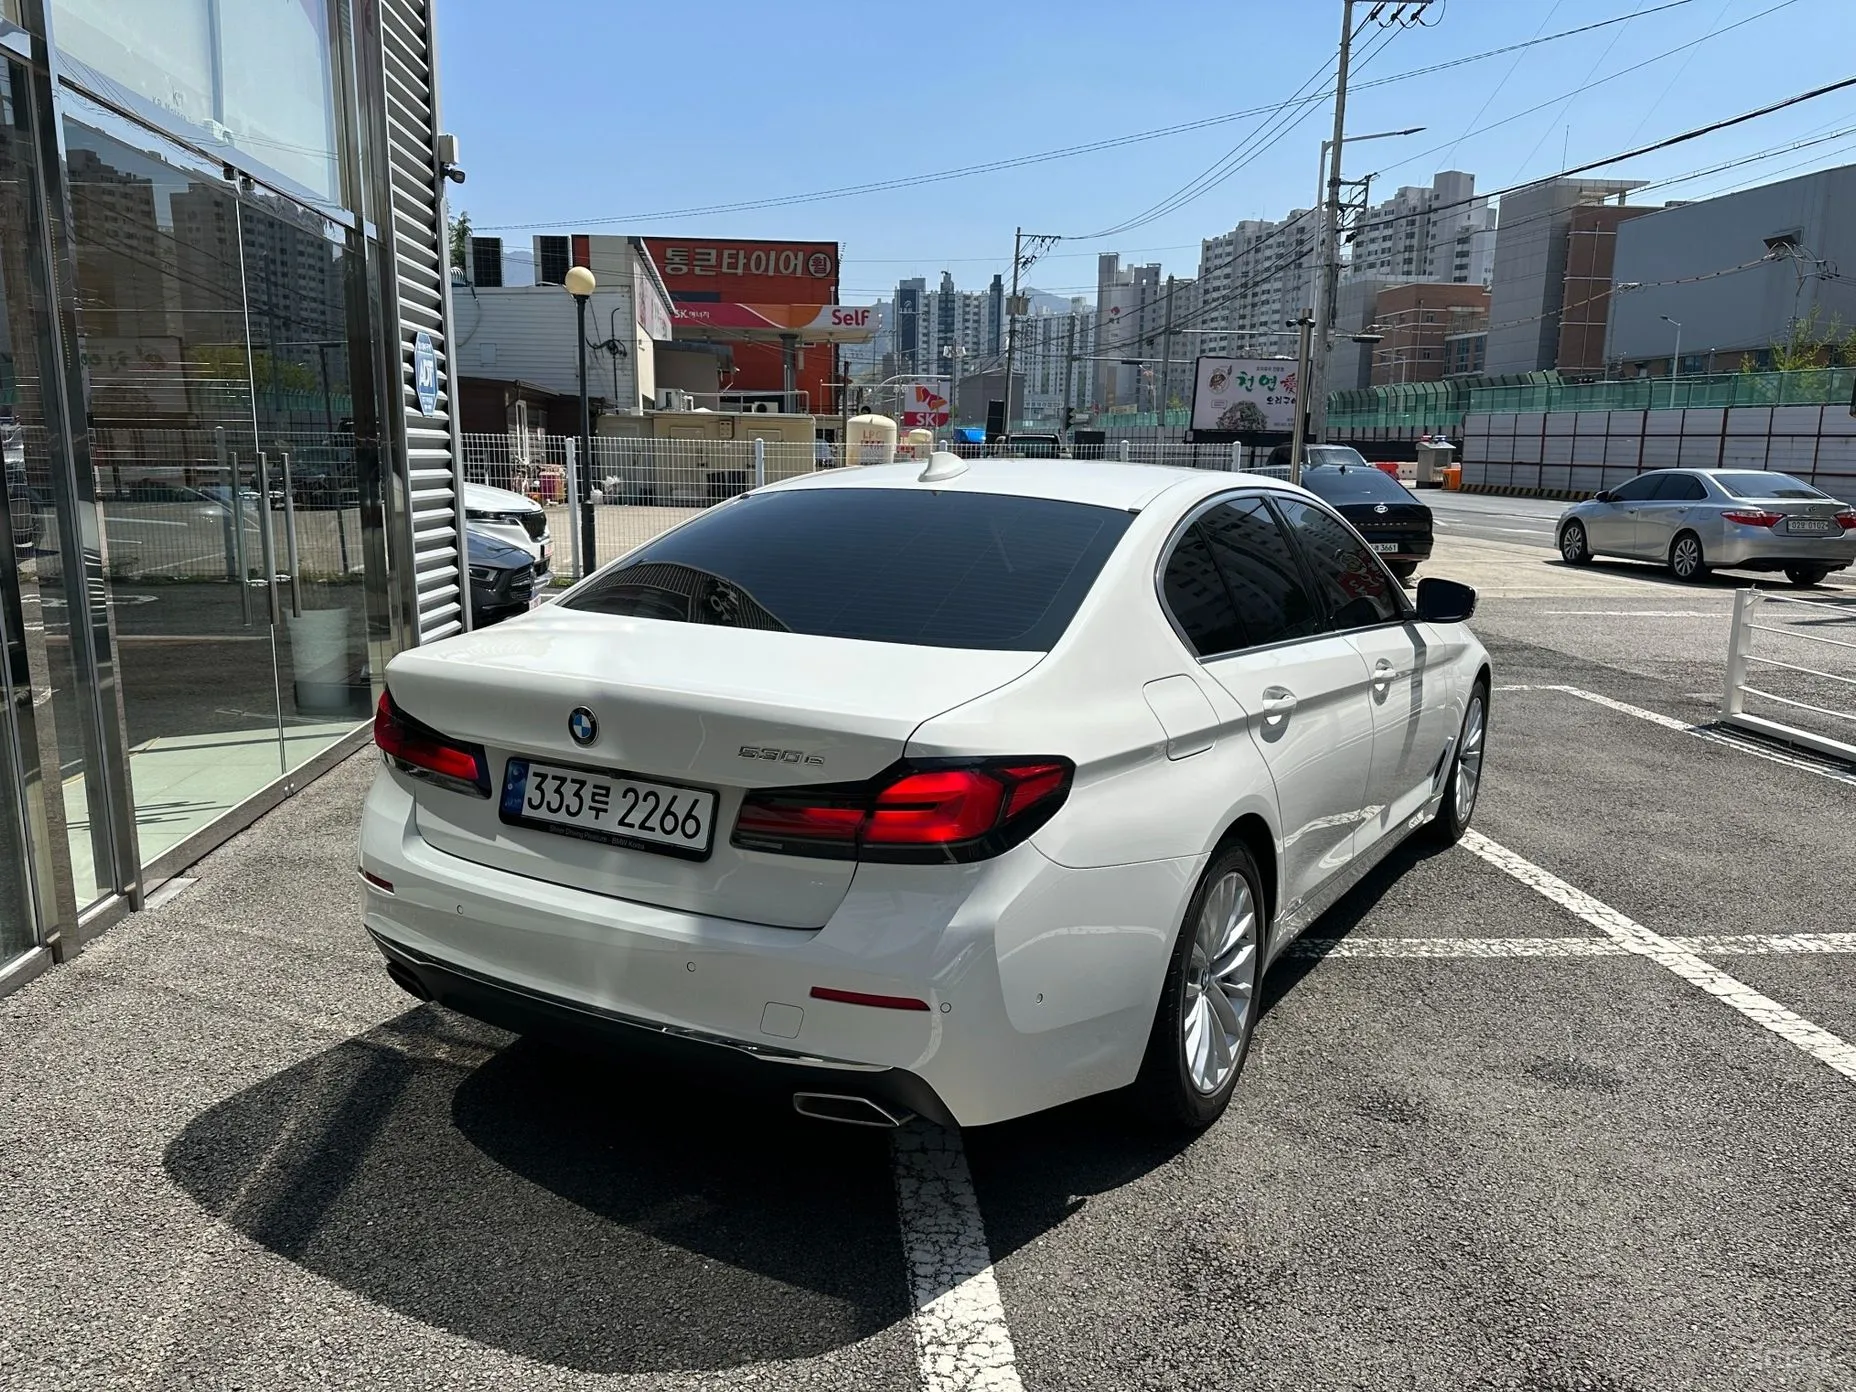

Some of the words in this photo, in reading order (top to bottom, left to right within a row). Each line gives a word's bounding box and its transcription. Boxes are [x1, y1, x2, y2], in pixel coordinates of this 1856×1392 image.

[664, 247, 804, 276] 통큰타이어
[809, 254, 831, 277] 휠
[831, 309, 871, 326] Self
[916, 412, 935, 426] SK
[737, 746, 825, 766] 530e
[526, 771, 611, 820] 333루
[618, 787, 702, 840] 2266
